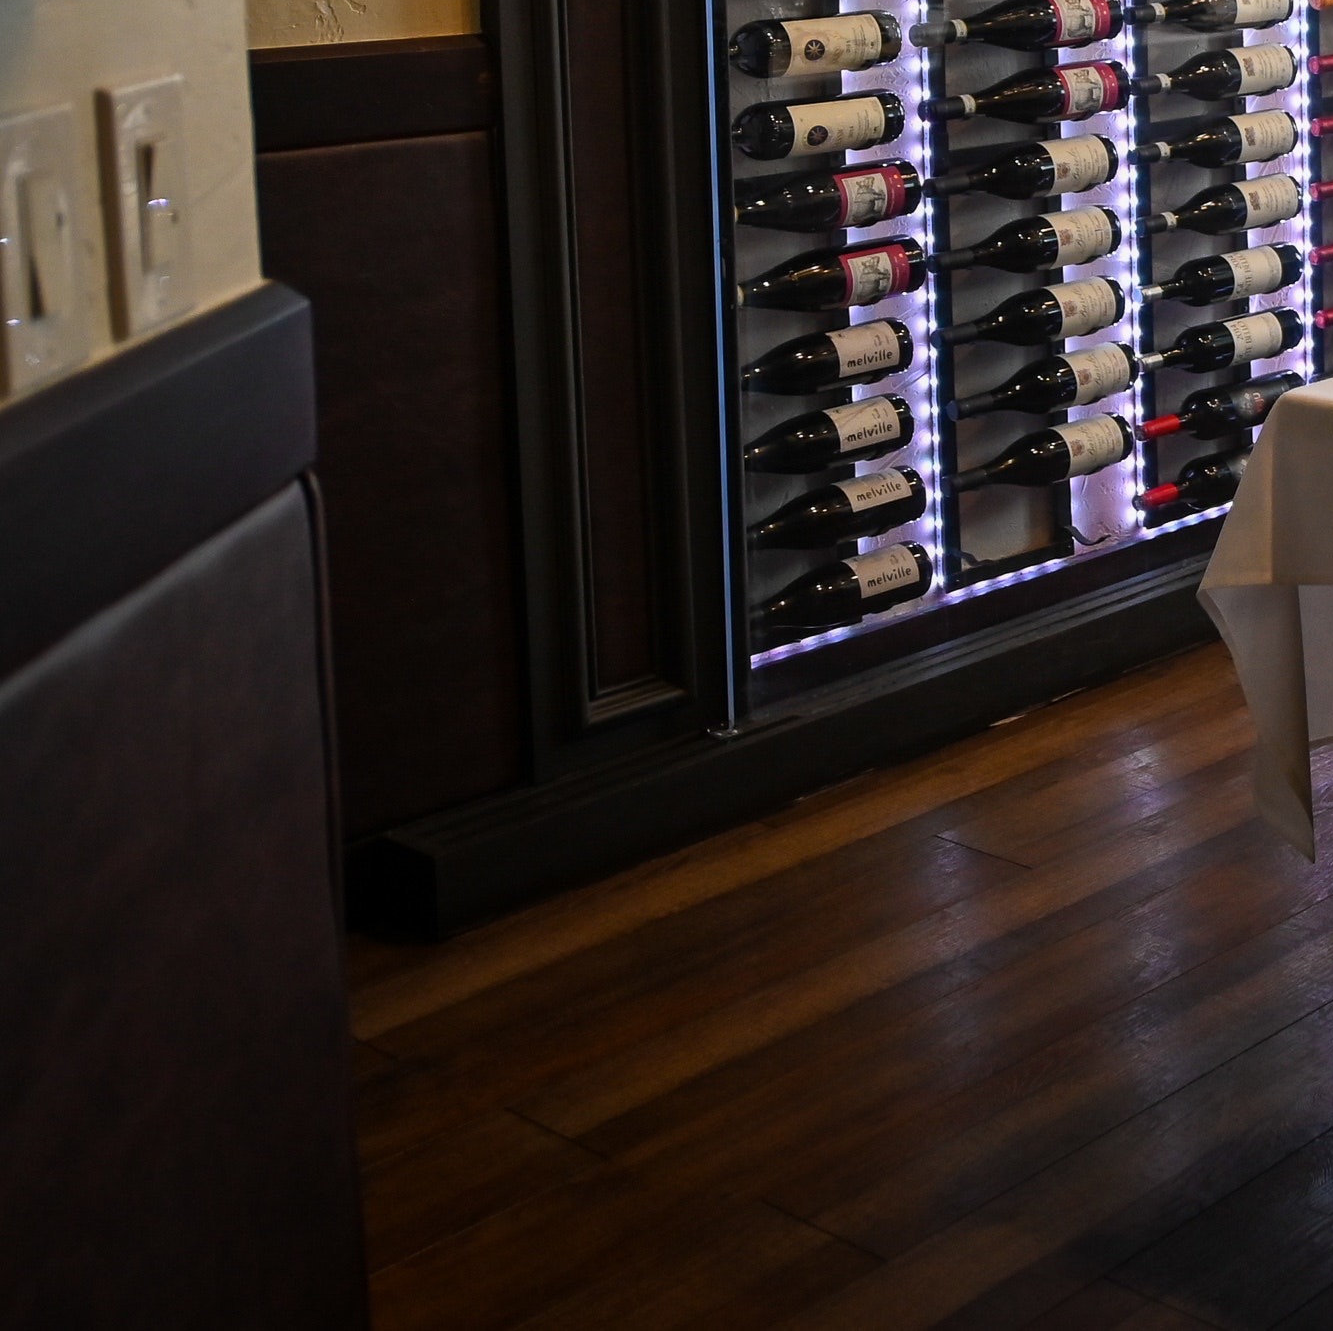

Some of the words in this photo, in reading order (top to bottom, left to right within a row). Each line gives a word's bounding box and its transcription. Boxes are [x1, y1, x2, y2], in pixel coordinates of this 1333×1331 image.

[847, 350, 893, 368] melville
[846, 422, 893, 442] melville
[856, 481, 902, 502] melville
[867, 566, 912, 588] melville
